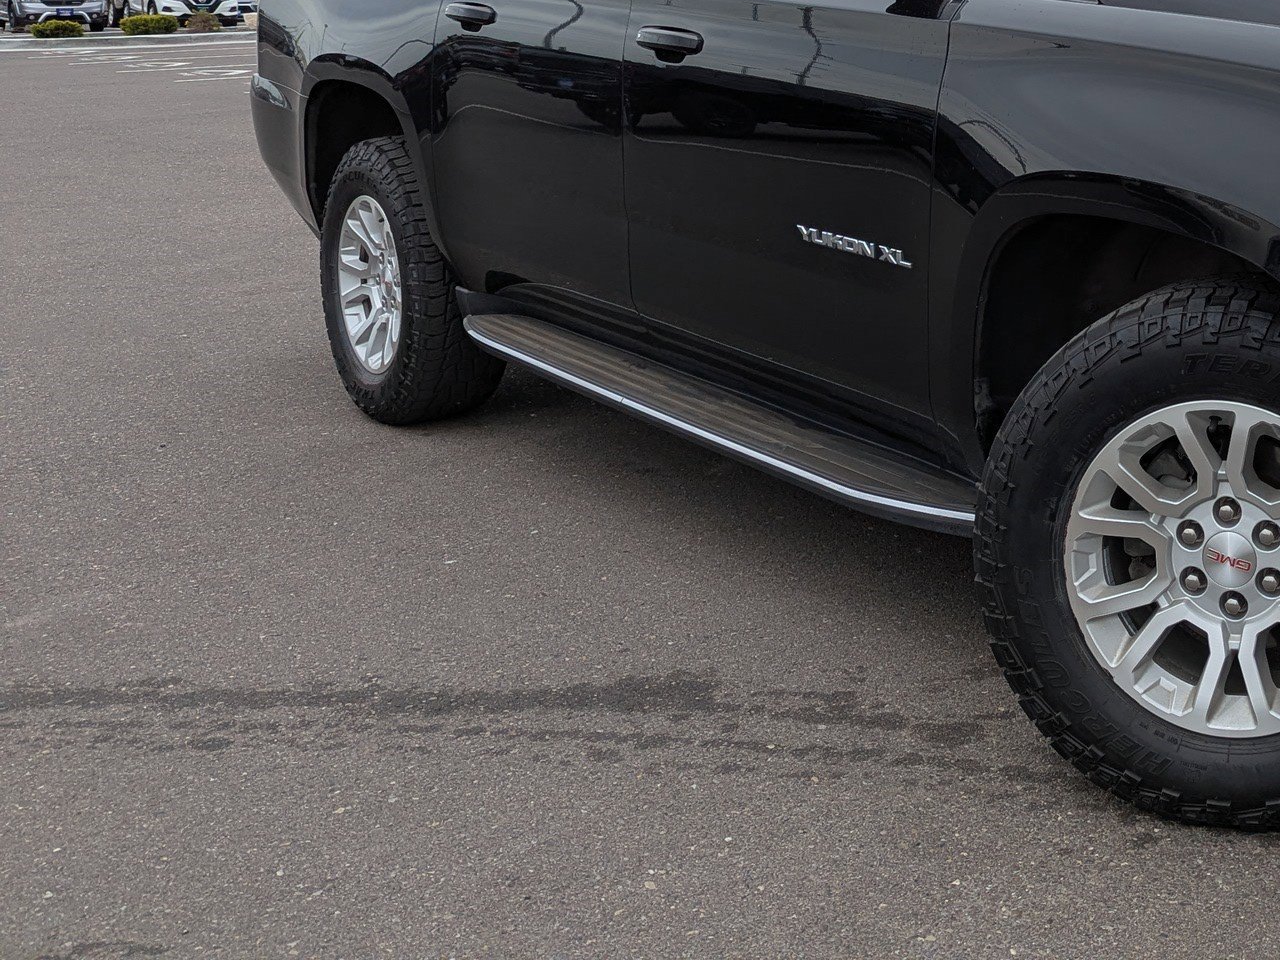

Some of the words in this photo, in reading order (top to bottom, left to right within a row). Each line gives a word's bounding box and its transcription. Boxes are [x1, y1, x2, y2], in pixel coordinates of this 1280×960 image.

[796, 224, 875, 259] YUKON
[878, 245, 912, 269] XL
[1206, 547, 1252, 572] GMC
